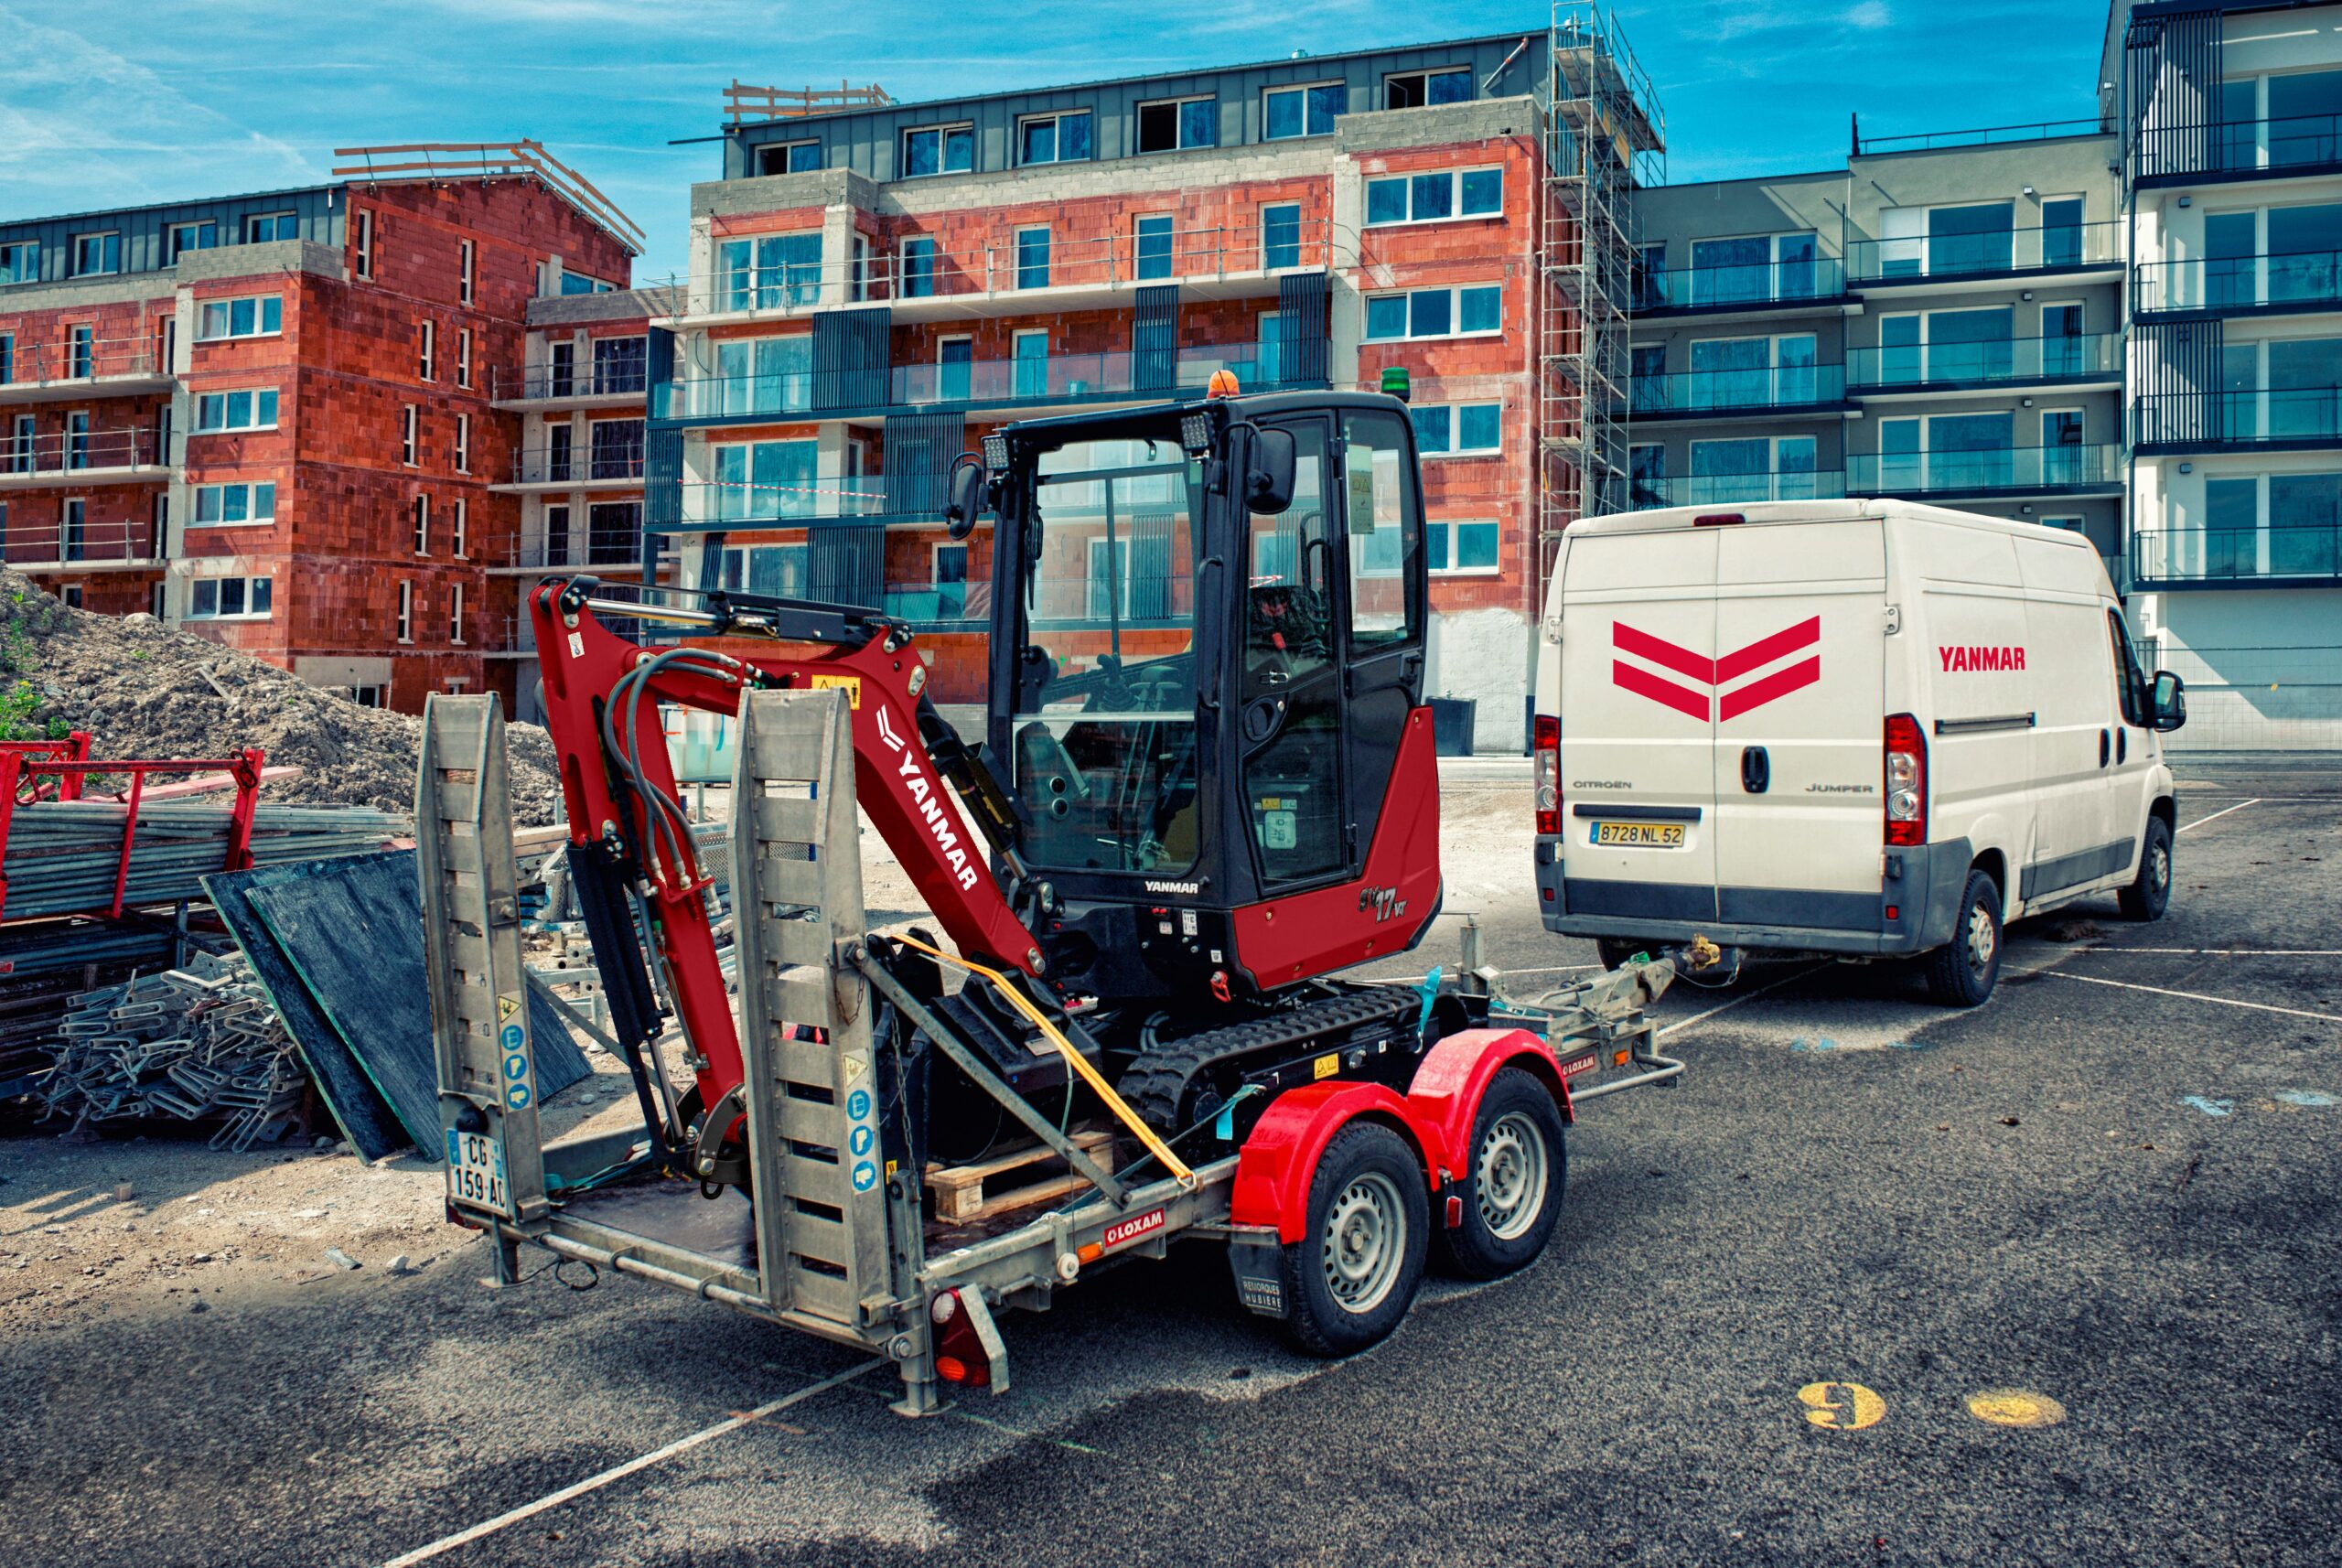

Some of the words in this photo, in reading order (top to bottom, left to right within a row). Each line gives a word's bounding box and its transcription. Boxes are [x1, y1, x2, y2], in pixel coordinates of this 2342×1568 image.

[1939, 646, 2025, 672] YANMAR
[1805, 783, 1874, 793] JUMPER
[898, 750, 978, 891] YANMAR
[1601, 826, 1638, 842] 8728
[1640, 827, 1658, 843] NL
[1662, 828, 1681, 843] 52
[1144, 880, 1198, 894] YANMAR
[1568, 1056, 1594, 1074] LOXAM
[468, 1136, 488, 1166] CG
[457, 1168, 483, 1200] 159
[1118, 1211, 1163, 1240] LOXAM
[1797, 1381, 1887, 1431] 9
